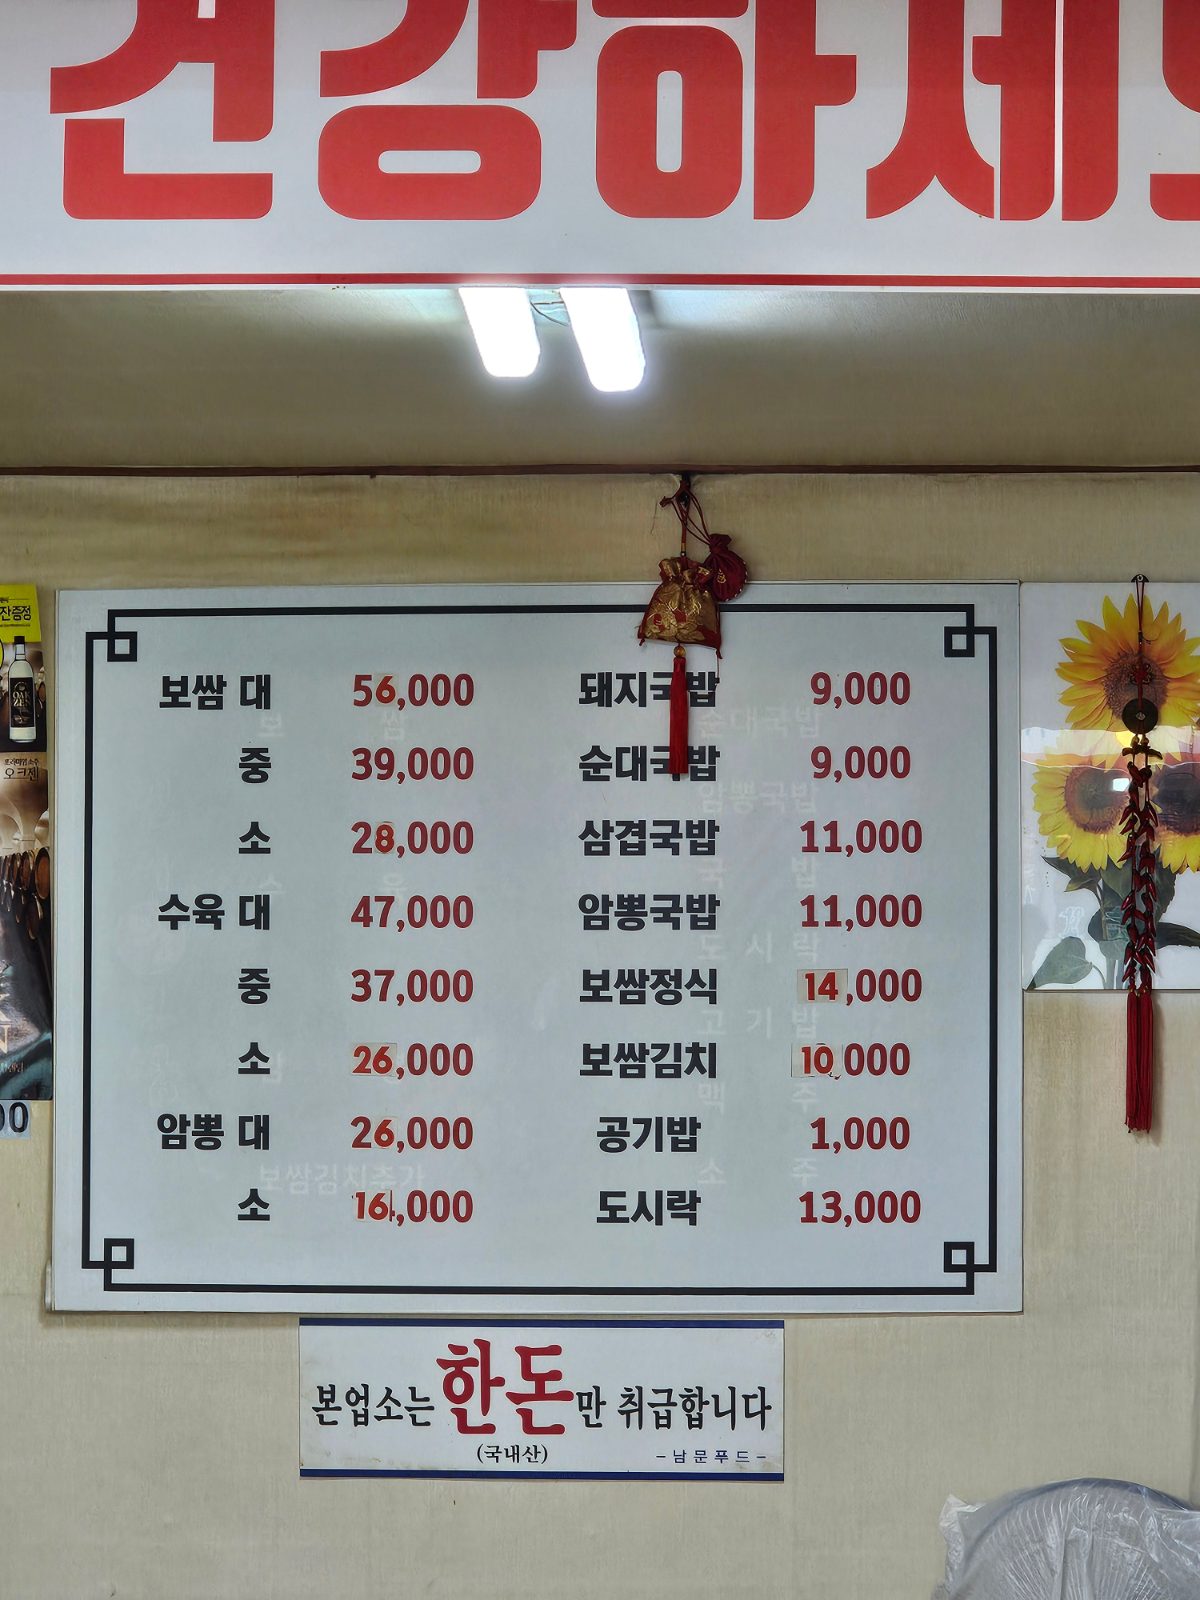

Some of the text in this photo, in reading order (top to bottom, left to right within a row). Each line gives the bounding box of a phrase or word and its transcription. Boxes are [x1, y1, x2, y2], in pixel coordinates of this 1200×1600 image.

[50, 0, 1200, 221] 건강하세
[159, 674, 271, 711] 보쌈 대
[353, 673, 475, 711] 56,000
[579, 671, 721, 708] 돼지국밥
[810, 671, 911, 709] 9,000
[238, 747, 272, 784] 중
[352, 747, 475, 785] 39,000
[579, 745, 721, 782] 순대국밥
[810, 745, 911, 783] 9,000
[238, 821, 272, 855] 소
[351, 821, 475, 859] 28,000
[578, 819, 721, 857] 삼겹국밥
[800, 820, 922, 858] 11,000
[158, 893, 271, 931] 수육 대
[350, 895, 474, 933] 47,000
[578, 893, 721, 931] 암뽕국밥
[800, 894, 922, 932] 11,000
[238, 968, 272, 1005] 중
[350, 968, 474, 1007] 37,000
[579, 968, 718, 1006] 보쌈정식
[804, 968, 922, 1006] 14,000
[237, 1041, 272, 1075] 소
[352, 1042, 474, 1080] 26,000
[579, 1041, 718, 1079] 보쌈김치
[801, 1042, 911, 1080] 10000
[0, 1101, 29, 1133] 0
[156, 1113, 271, 1151] 암뽕 대
[350, 1116, 474, 1154] 26,000
[596, 1115, 702, 1153] 공기밥
[810, 1116, 911, 1154] 1,000
[237, 1188, 272, 1222] 소
[352, 1189, 474, 1227] 16,000
[596, 1189, 703, 1227] 도시락
[799, 1190, 922, 1228] 13,000
[617, 1385, 773, 1432] 취급합니다
[476, 1443, 549, 1465] (국내산)
